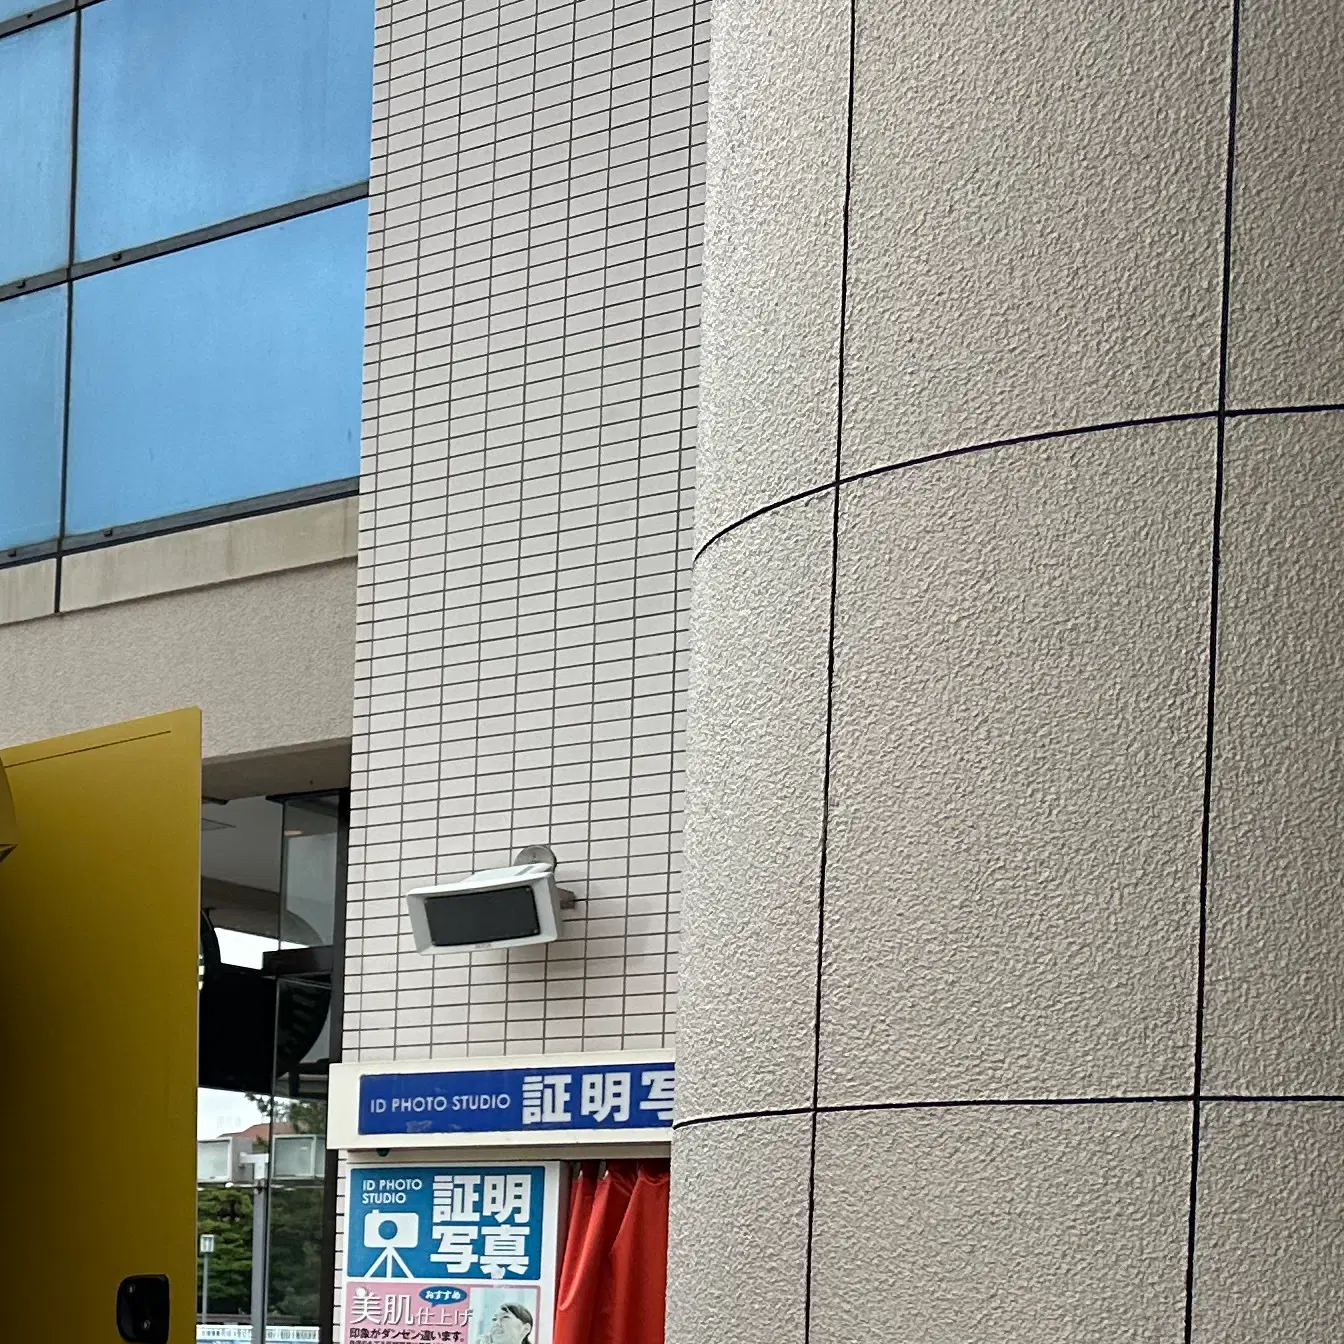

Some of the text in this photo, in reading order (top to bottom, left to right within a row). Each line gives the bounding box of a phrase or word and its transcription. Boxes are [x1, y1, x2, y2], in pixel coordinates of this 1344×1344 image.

[370, 1093, 511, 1113] ID PHOTO STUDIO
[362, 1178, 423, 1191] ID PHOTO
[362, 1192, 407, 1205] STUDIO
[432, 1174, 531, 1224] 証明
[430, 1223, 530, 1275] 写真
[425, 1289, 461, 1300] おすすめ
